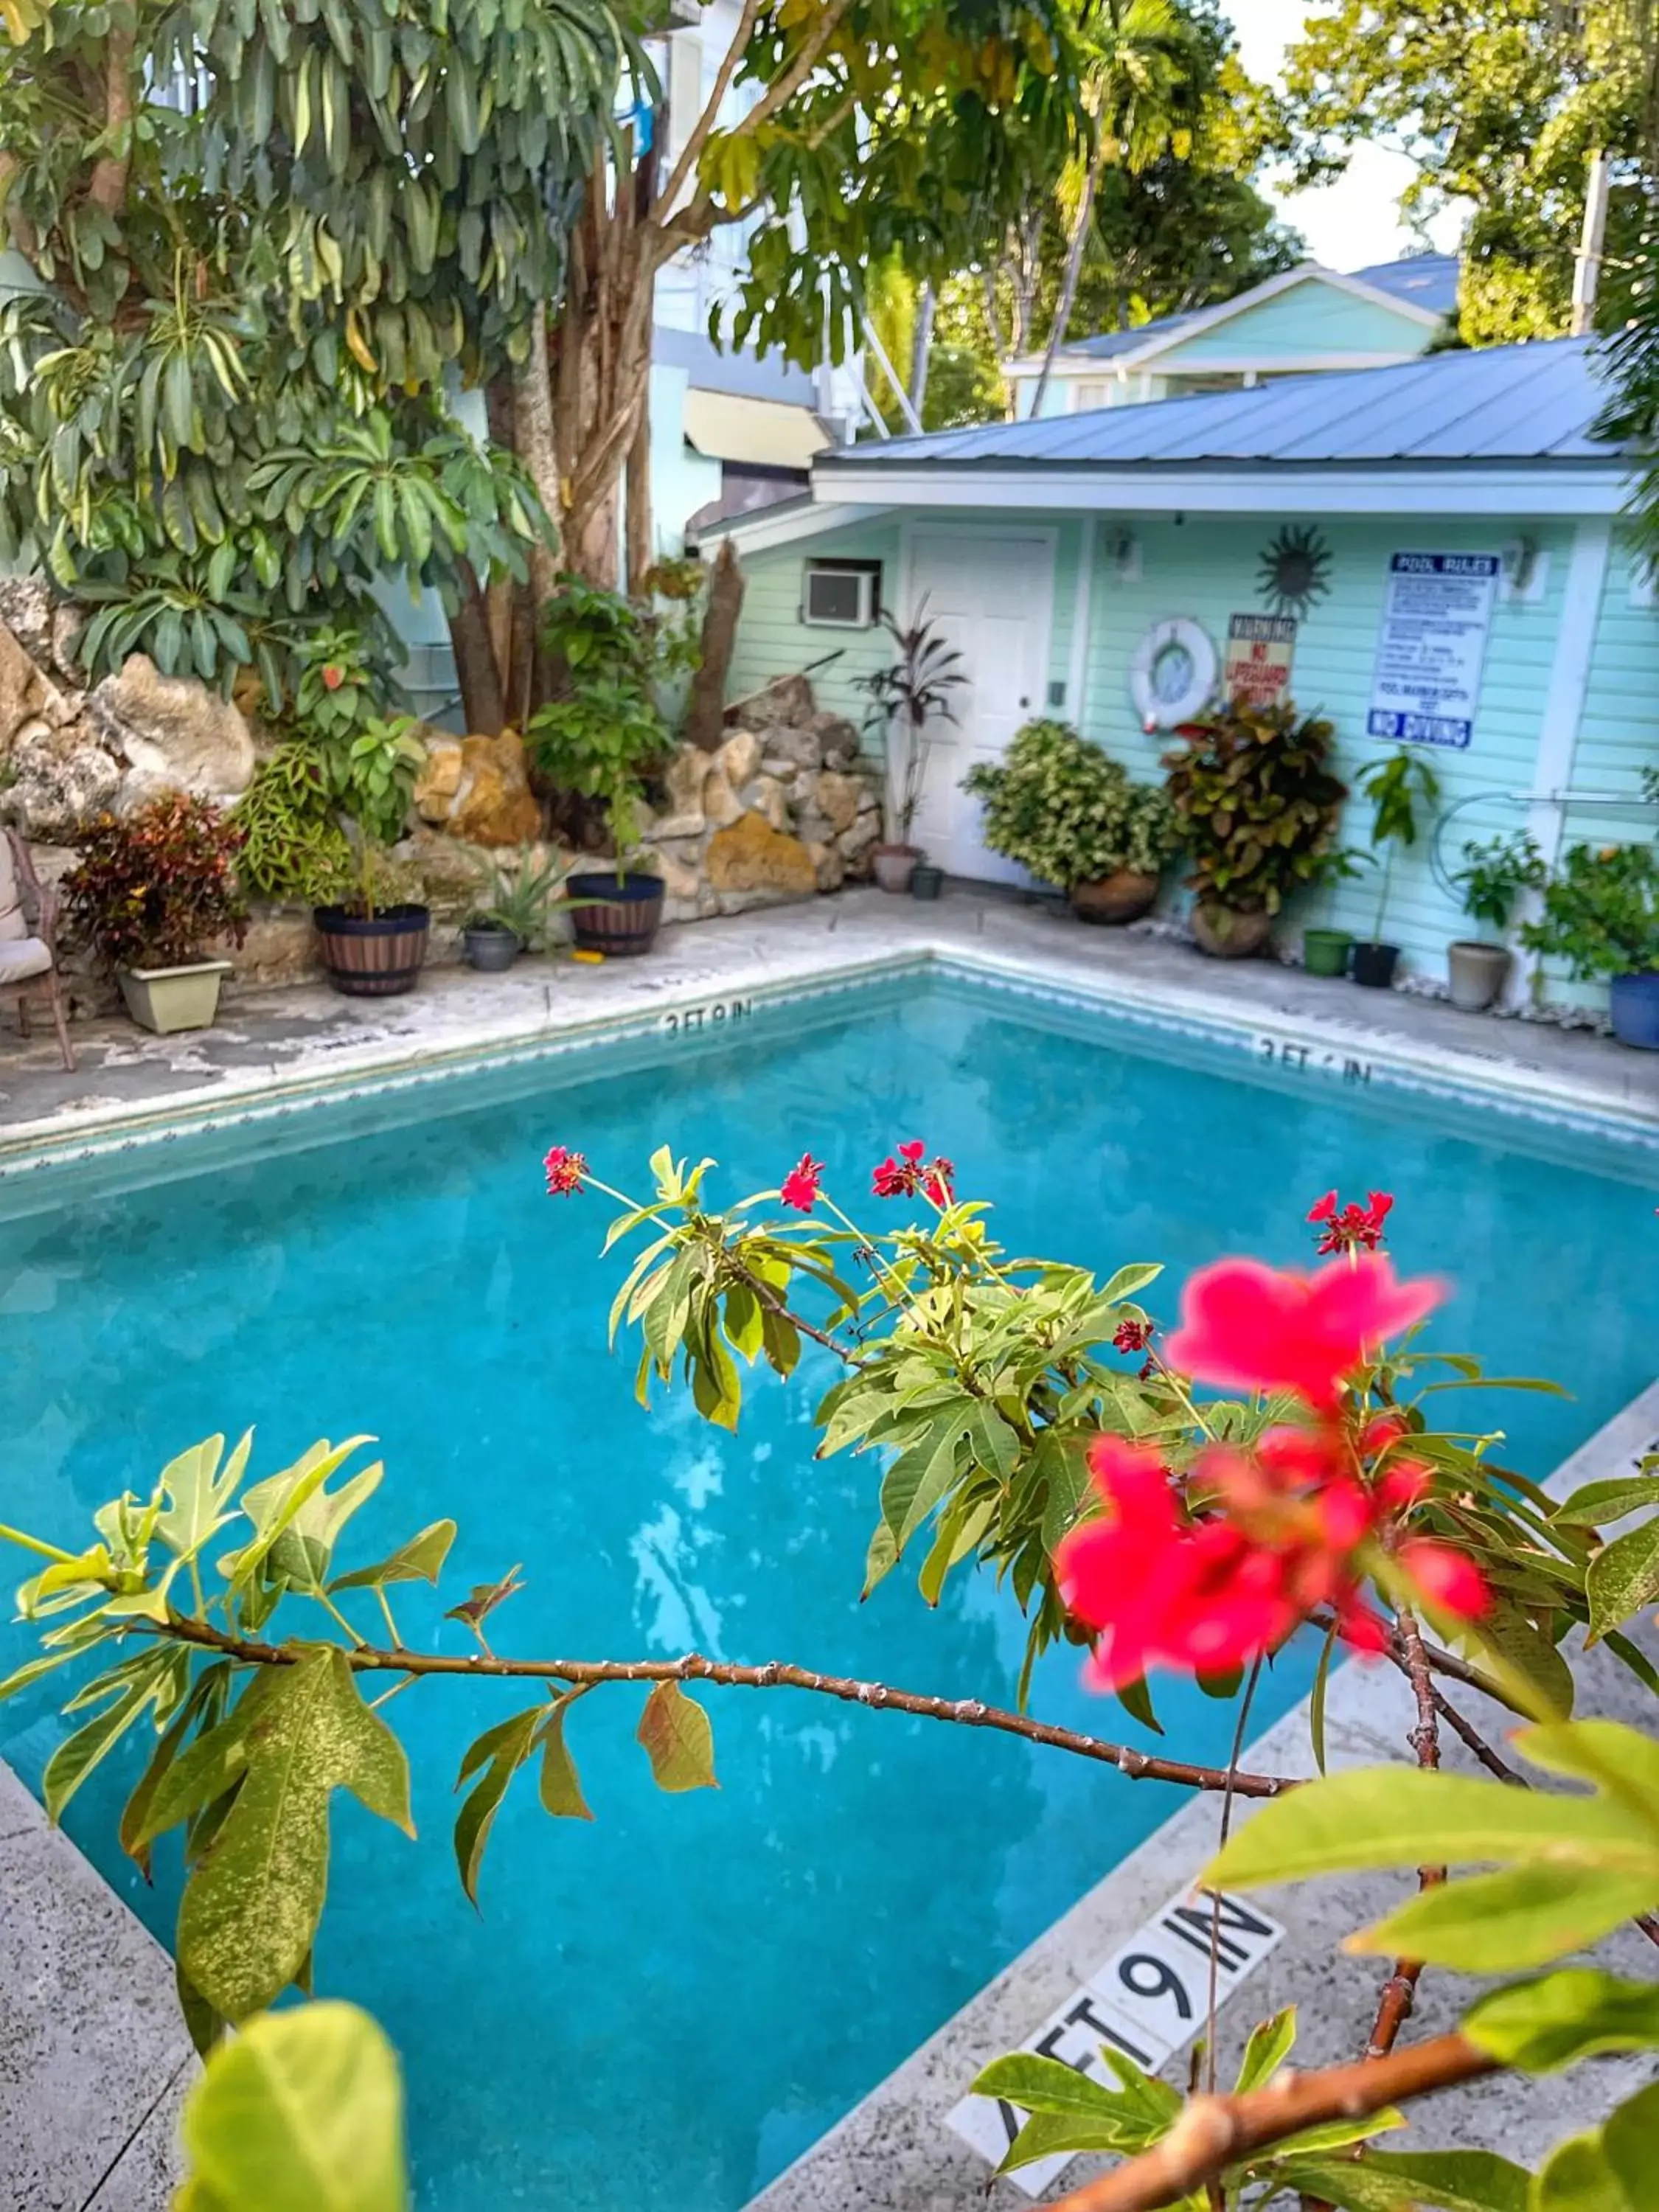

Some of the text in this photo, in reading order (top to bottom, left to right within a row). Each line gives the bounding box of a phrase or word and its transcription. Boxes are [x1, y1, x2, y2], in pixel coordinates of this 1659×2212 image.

[1397, 555, 1435, 571] POOL
[1373, 712, 1467, 745] NO DIVING
[684, 1008, 706, 1031] FT
[732, 998, 751, 1018] IN
[1283, 1044, 1310, 1072] FT
[1344, 1059, 1371, 1085] IN
[1117, 1952, 1194, 2020] 9
[1161, 1888, 1274, 1972] IN
